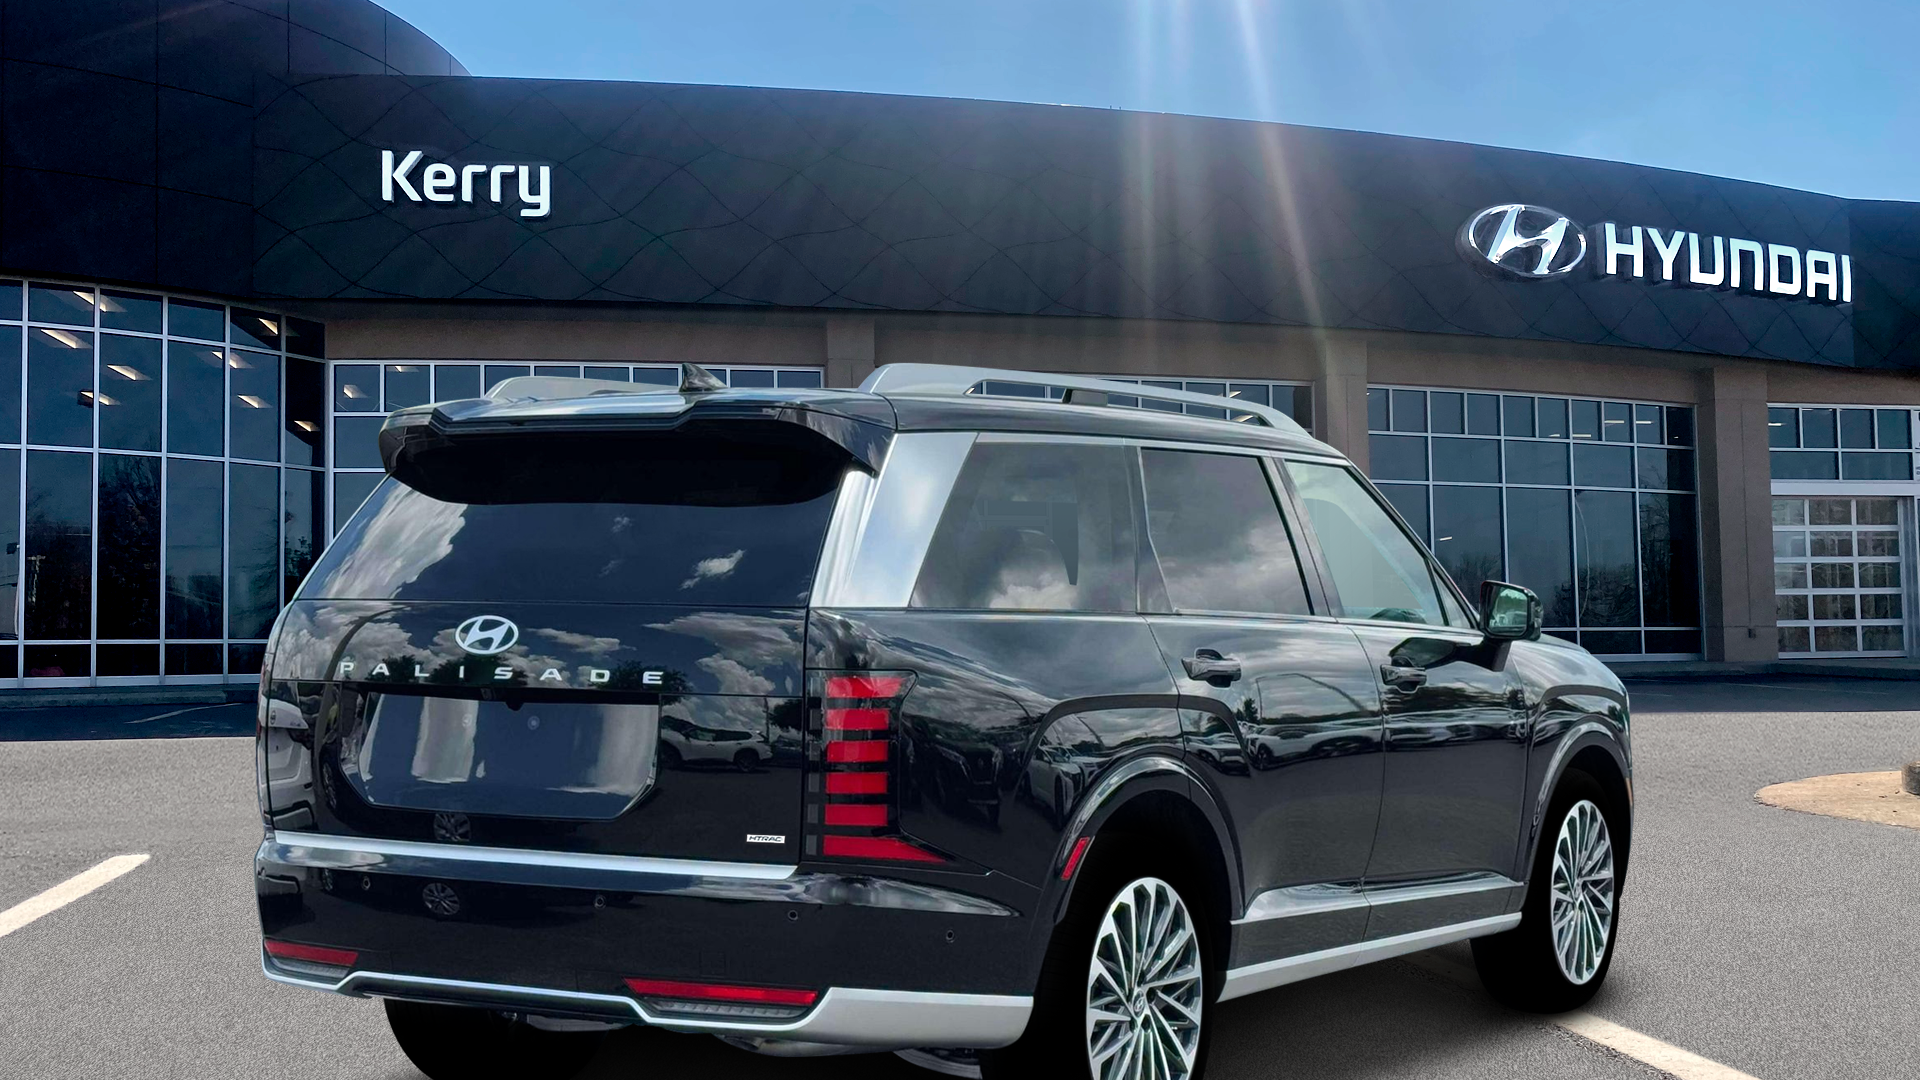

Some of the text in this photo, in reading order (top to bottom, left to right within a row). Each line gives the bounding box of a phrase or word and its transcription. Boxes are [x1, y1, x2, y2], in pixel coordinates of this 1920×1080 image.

[381, 150, 551, 217] Kerry
[1605, 222, 1852, 303] HYUNDAI
[340, 661, 664, 684] PALISADE
